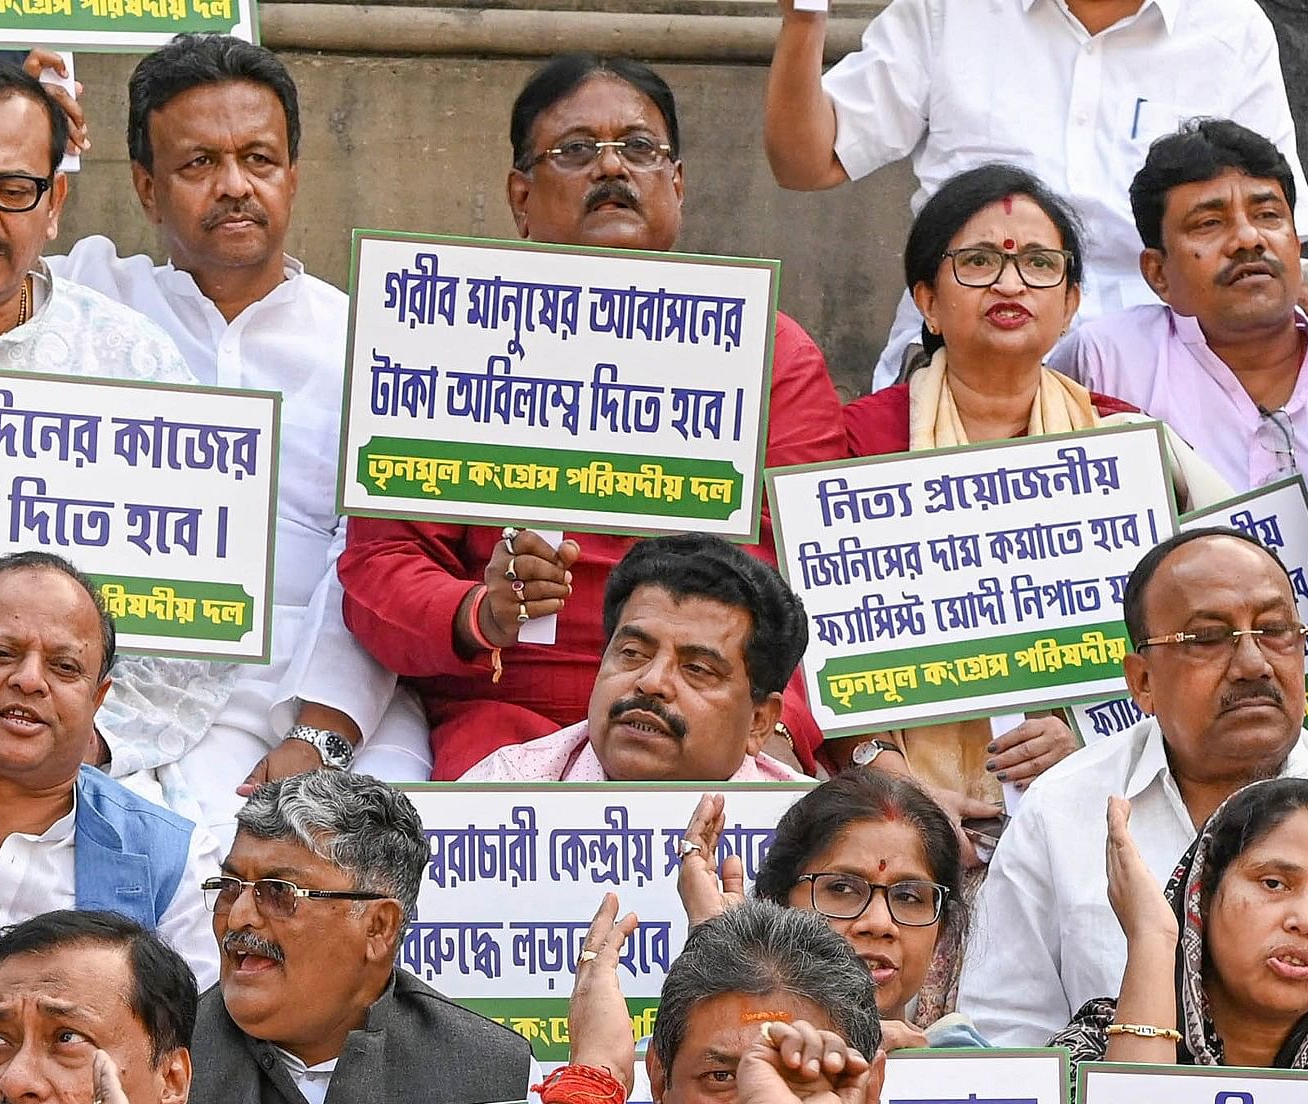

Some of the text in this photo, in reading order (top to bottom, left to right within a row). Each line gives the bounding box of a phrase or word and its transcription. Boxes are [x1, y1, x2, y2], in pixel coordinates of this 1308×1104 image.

[384, 253, 744, 360] গরীব মানুষের আবাসনের
[370, 354, 437, 419] টাকা
[446, 355, 584, 437] অবিলম্বে
[589, 363, 663, 434] দিতে
[670, 387, 724, 440] হবে
[113, 416, 259, 482] কাজের
[467, 461, 557, 491] কংগ্রেস
[564, 461, 683, 502] পরিষদীয়
[689, 476, 732, 503] দল
[817, 446, 1118, 528] নিত্য প্রয়োজনীয়
[9, 476, 113, 548] দিতে
[125, 503, 200, 557] হবে
[798, 537, 921, 590] জিনিসের
[926, 534, 979, 573] দাম
[988, 522, 1081, 562] কমাতে
[1089, 514, 1138, 551] হবে
[200, 599, 243, 625] দল
[812, 594, 924, 647] ফ্যাসিস্ট
[931, 577, 1005, 633] মোদী
[1009, 574, 1099, 623] নিপাত
[921, 652, 1007, 685] কংগ্রেস
[1014, 631, 1127, 672] পরিষদীয়
[548, 806, 652, 888] কেন্দ্রীয়
